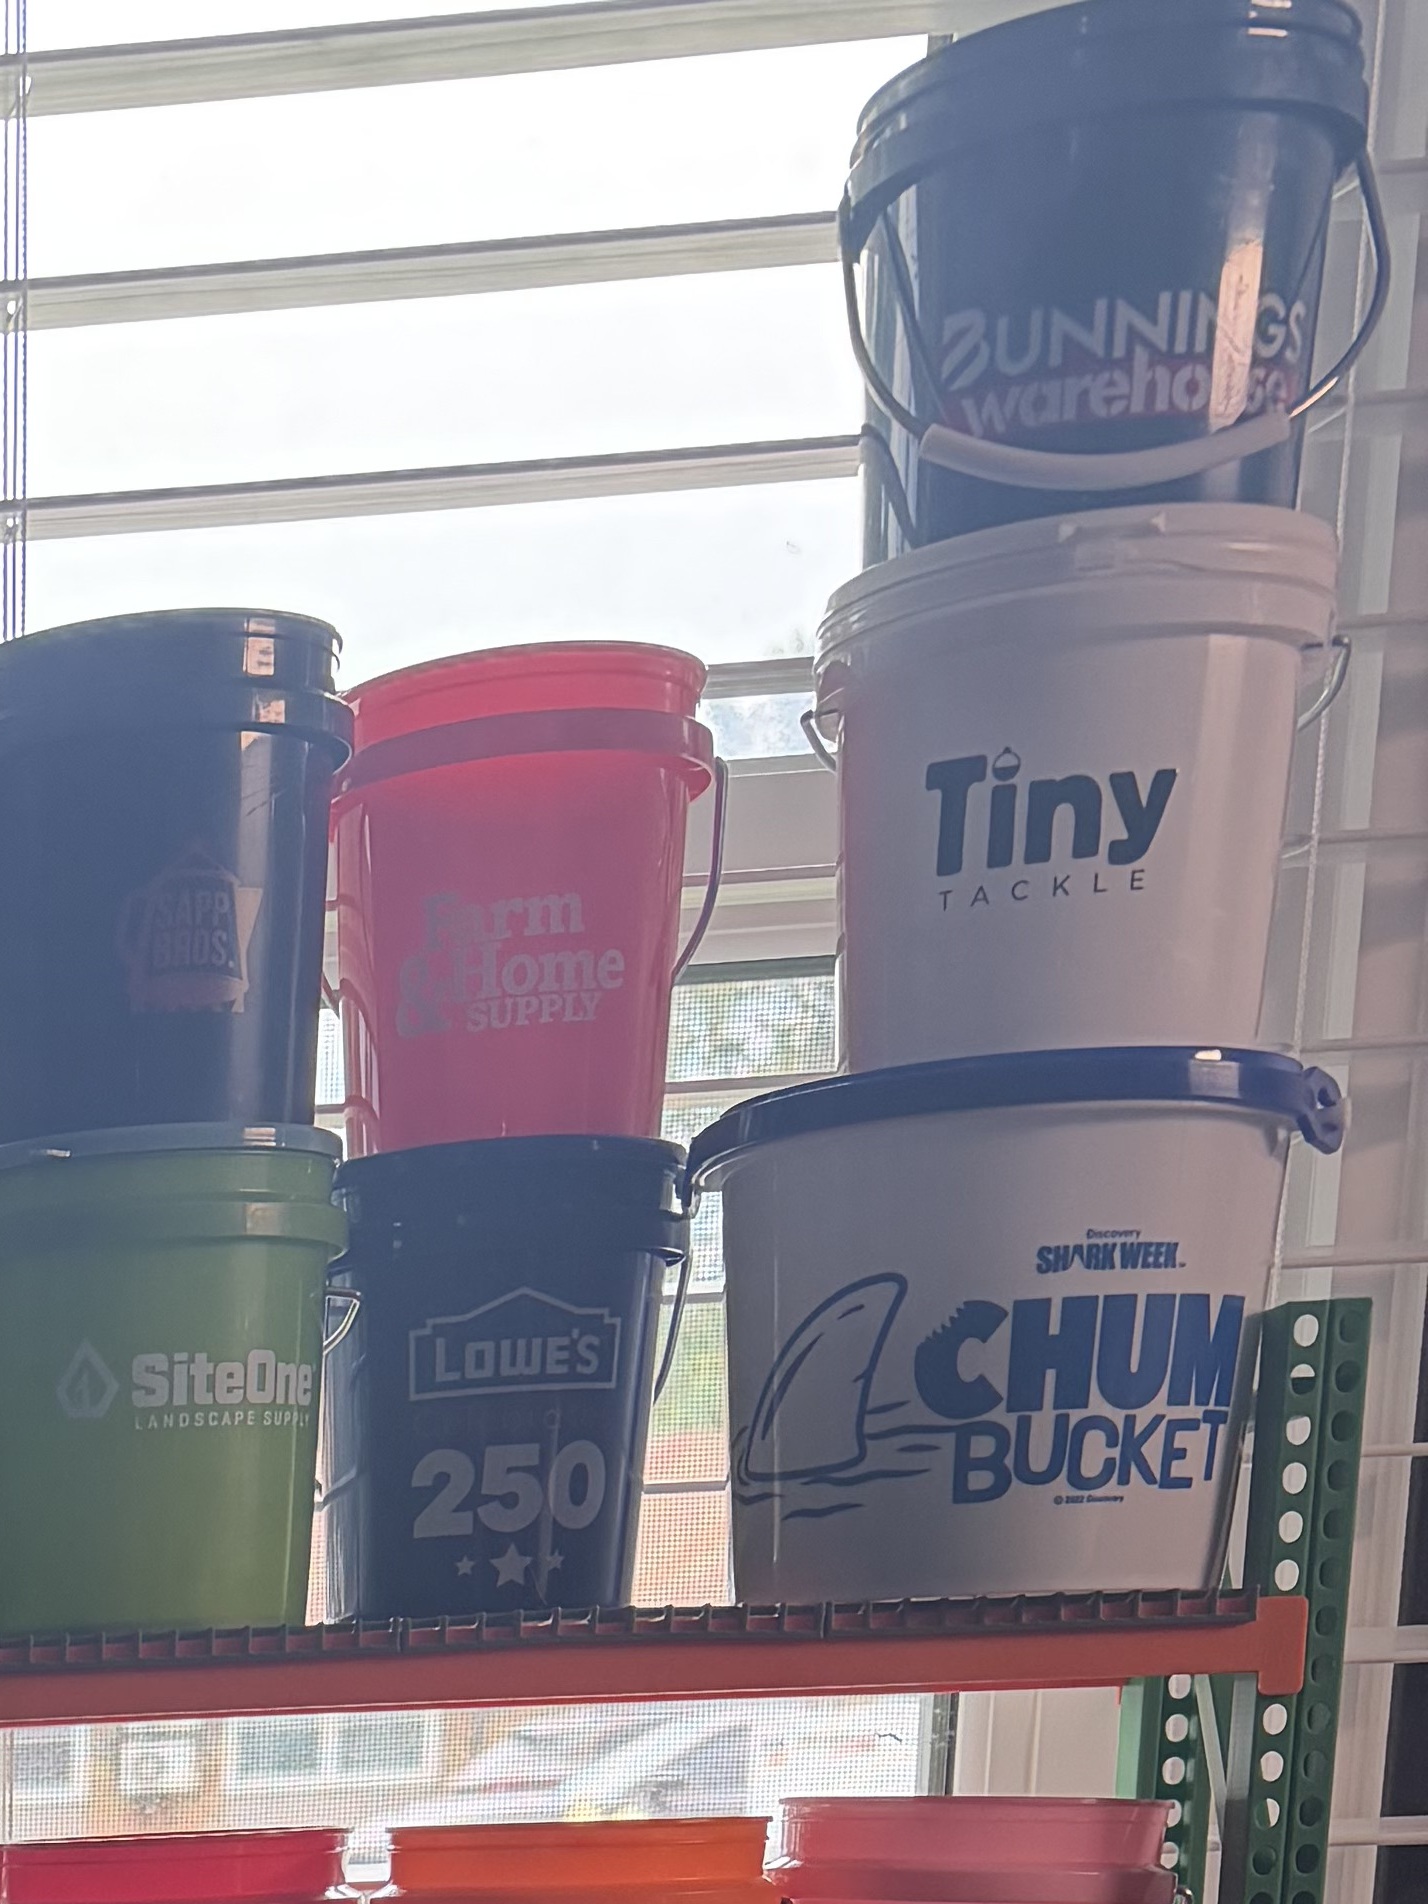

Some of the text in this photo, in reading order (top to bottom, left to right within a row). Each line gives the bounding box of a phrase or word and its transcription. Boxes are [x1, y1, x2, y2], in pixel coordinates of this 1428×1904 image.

[962, 346, 1290, 438] warehose
[926, 747, 1178, 877] Tiny
[938, 869, 1146, 911] TACKLE
[422, 892, 585, 942] Farm
[455, 949, 627, 1000] Home
[465, 992, 602, 1032] SUPPLY
[1037, 1241, 1179, 1274] SHARK WEEK
[130, 1349, 312, 1407] SiteOne
[435, 1329, 600, 1382] LOWE'S
[914, 1293, 1245, 1420] CHUM
[135, 1409, 311, 1430] LANDSCAPE SUPPLY
[953, 1408, 1232, 1505] BUCKET
[410, 1439, 608, 1540] 250
